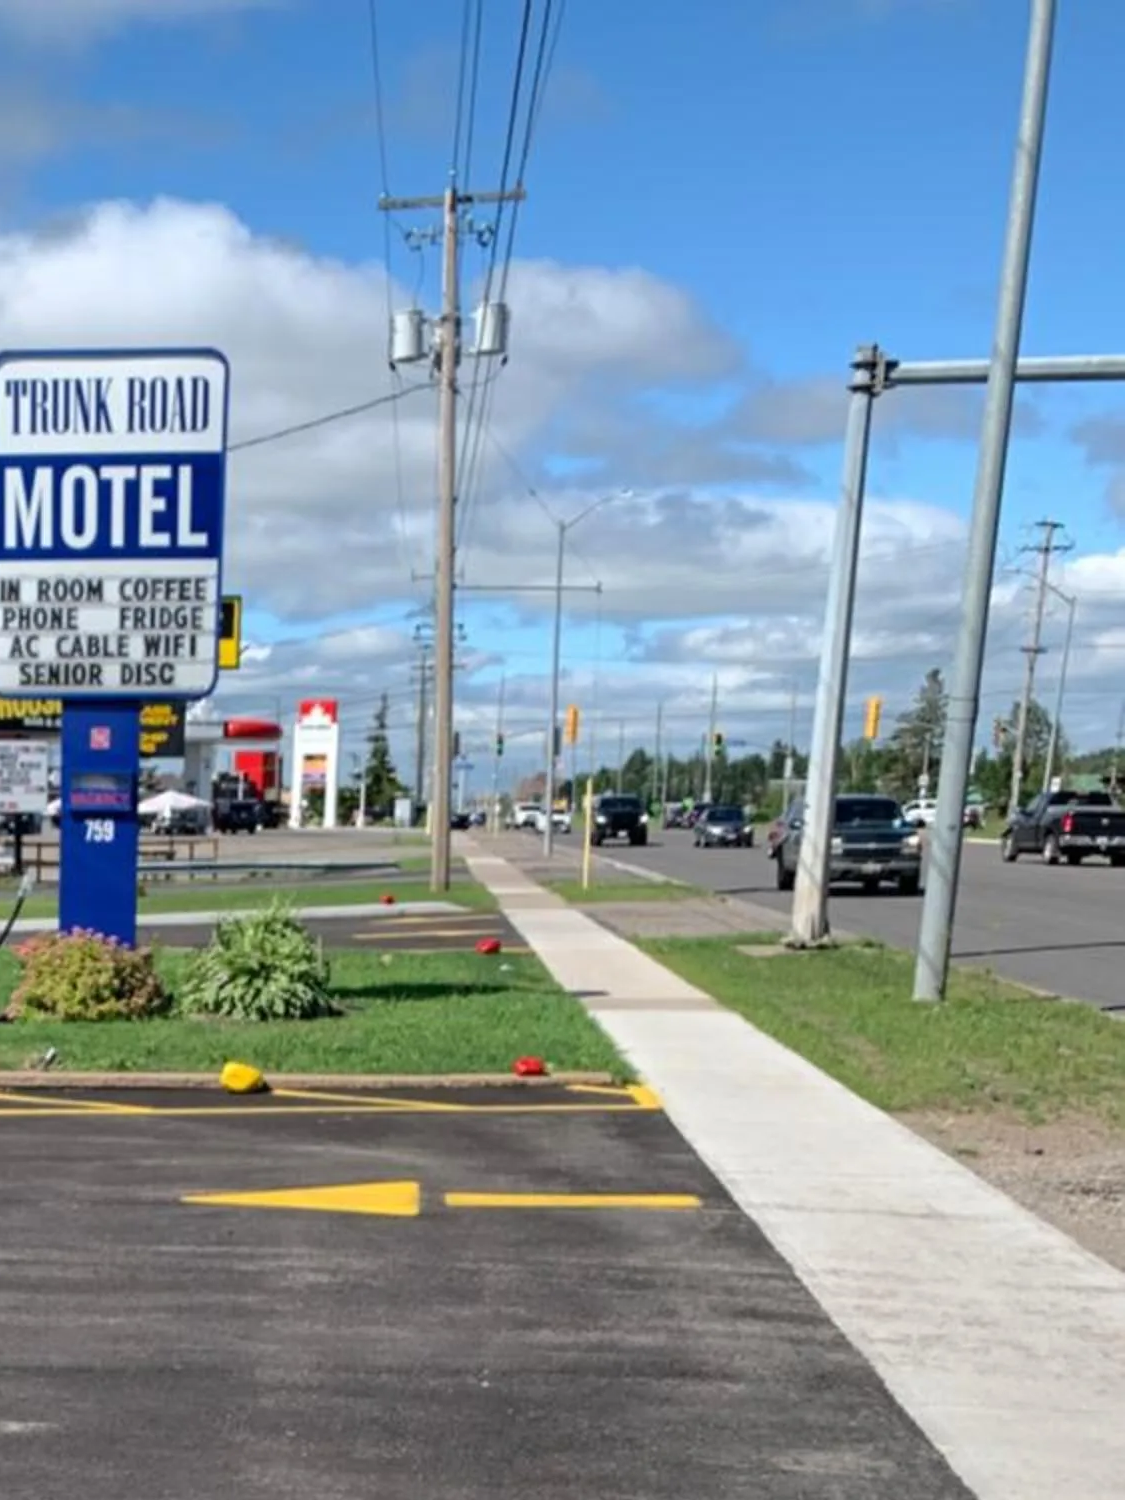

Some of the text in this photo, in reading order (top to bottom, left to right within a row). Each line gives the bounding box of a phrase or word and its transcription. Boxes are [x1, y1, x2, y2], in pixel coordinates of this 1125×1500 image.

[5, 375, 210, 435] TRUNK ROAD
[3, 464, 209, 549] MOTEL
[0, 578, 207, 601] IN ROOM COFFEE
[2, 606, 204, 630] PHONE FRIDGE
[9, 634, 197, 658] AC CABLE WIFI
[19, 663, 175, 685] SENIOR DISC
[84, 819, 115, 842] 759
